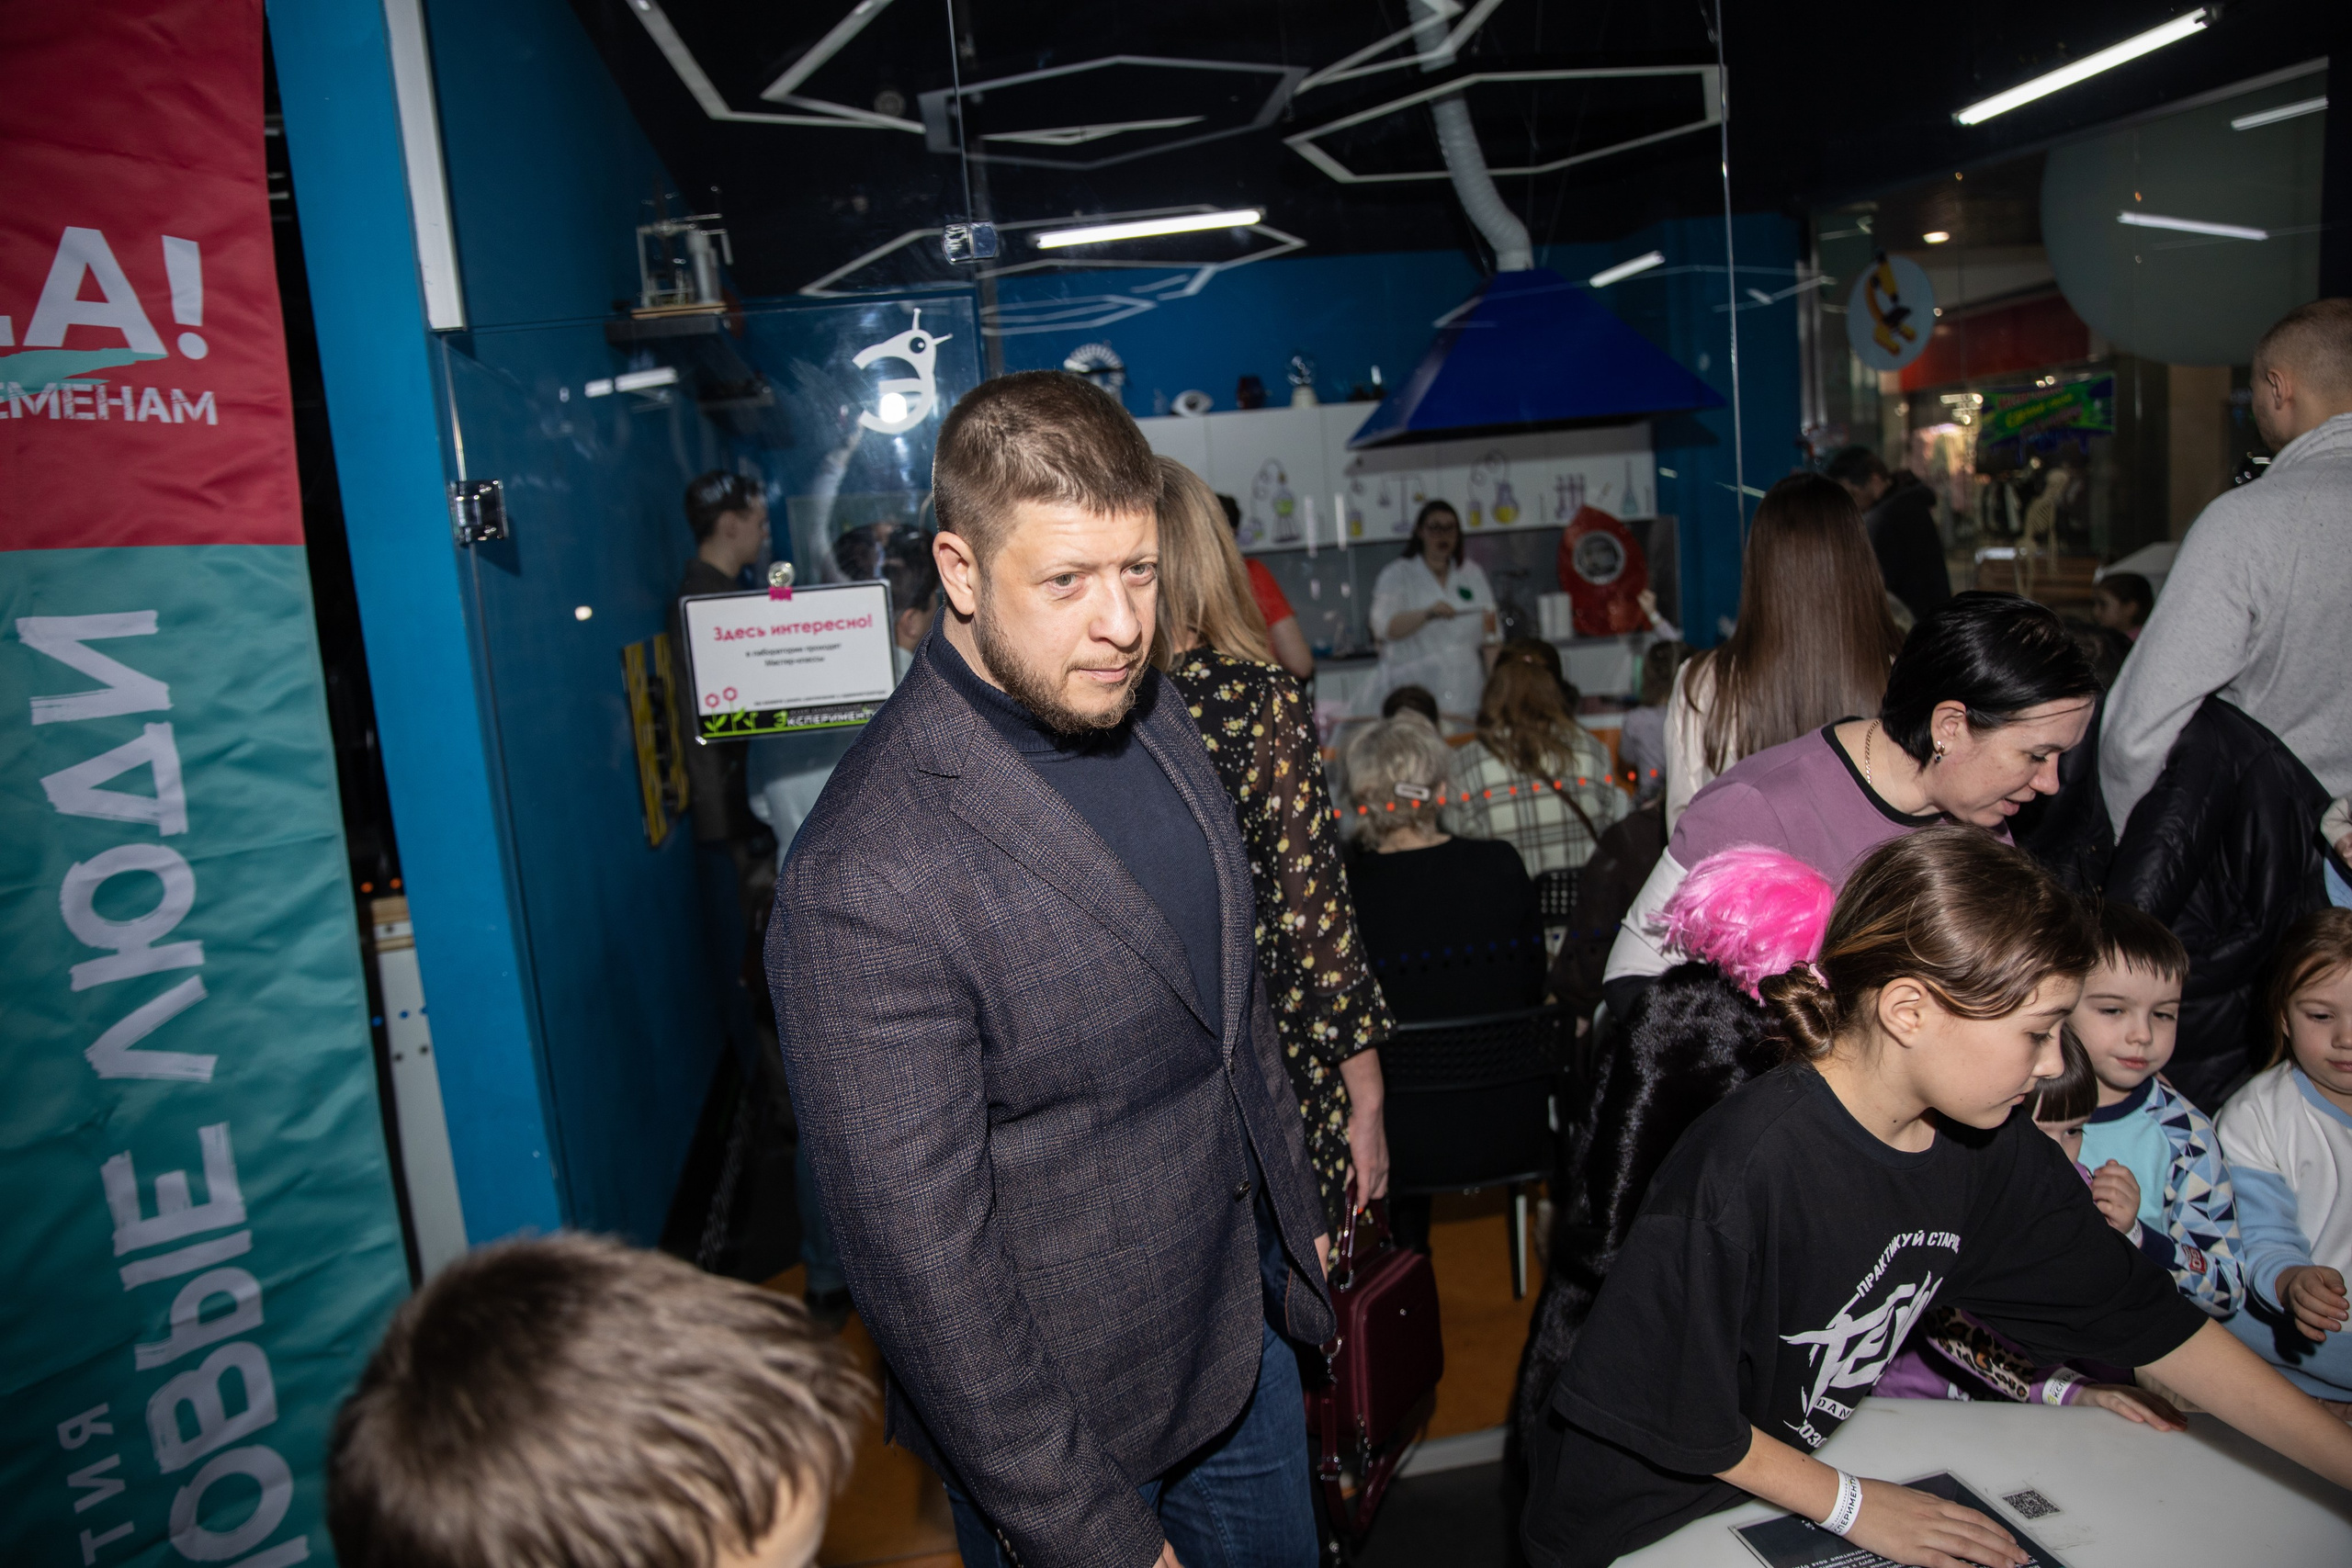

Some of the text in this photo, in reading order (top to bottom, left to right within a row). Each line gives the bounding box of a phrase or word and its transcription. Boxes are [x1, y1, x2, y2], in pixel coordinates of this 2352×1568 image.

[0, 226, 209, 360] А!
[0, 381, 219, 425] МЕНАМ
[713, 614, 873, 641] Здесь интересно!
[15, 609, 219, 1084] ЛЮДИ
[1856, 1229, 1926, 1298] ПРАКТИКУЙ
